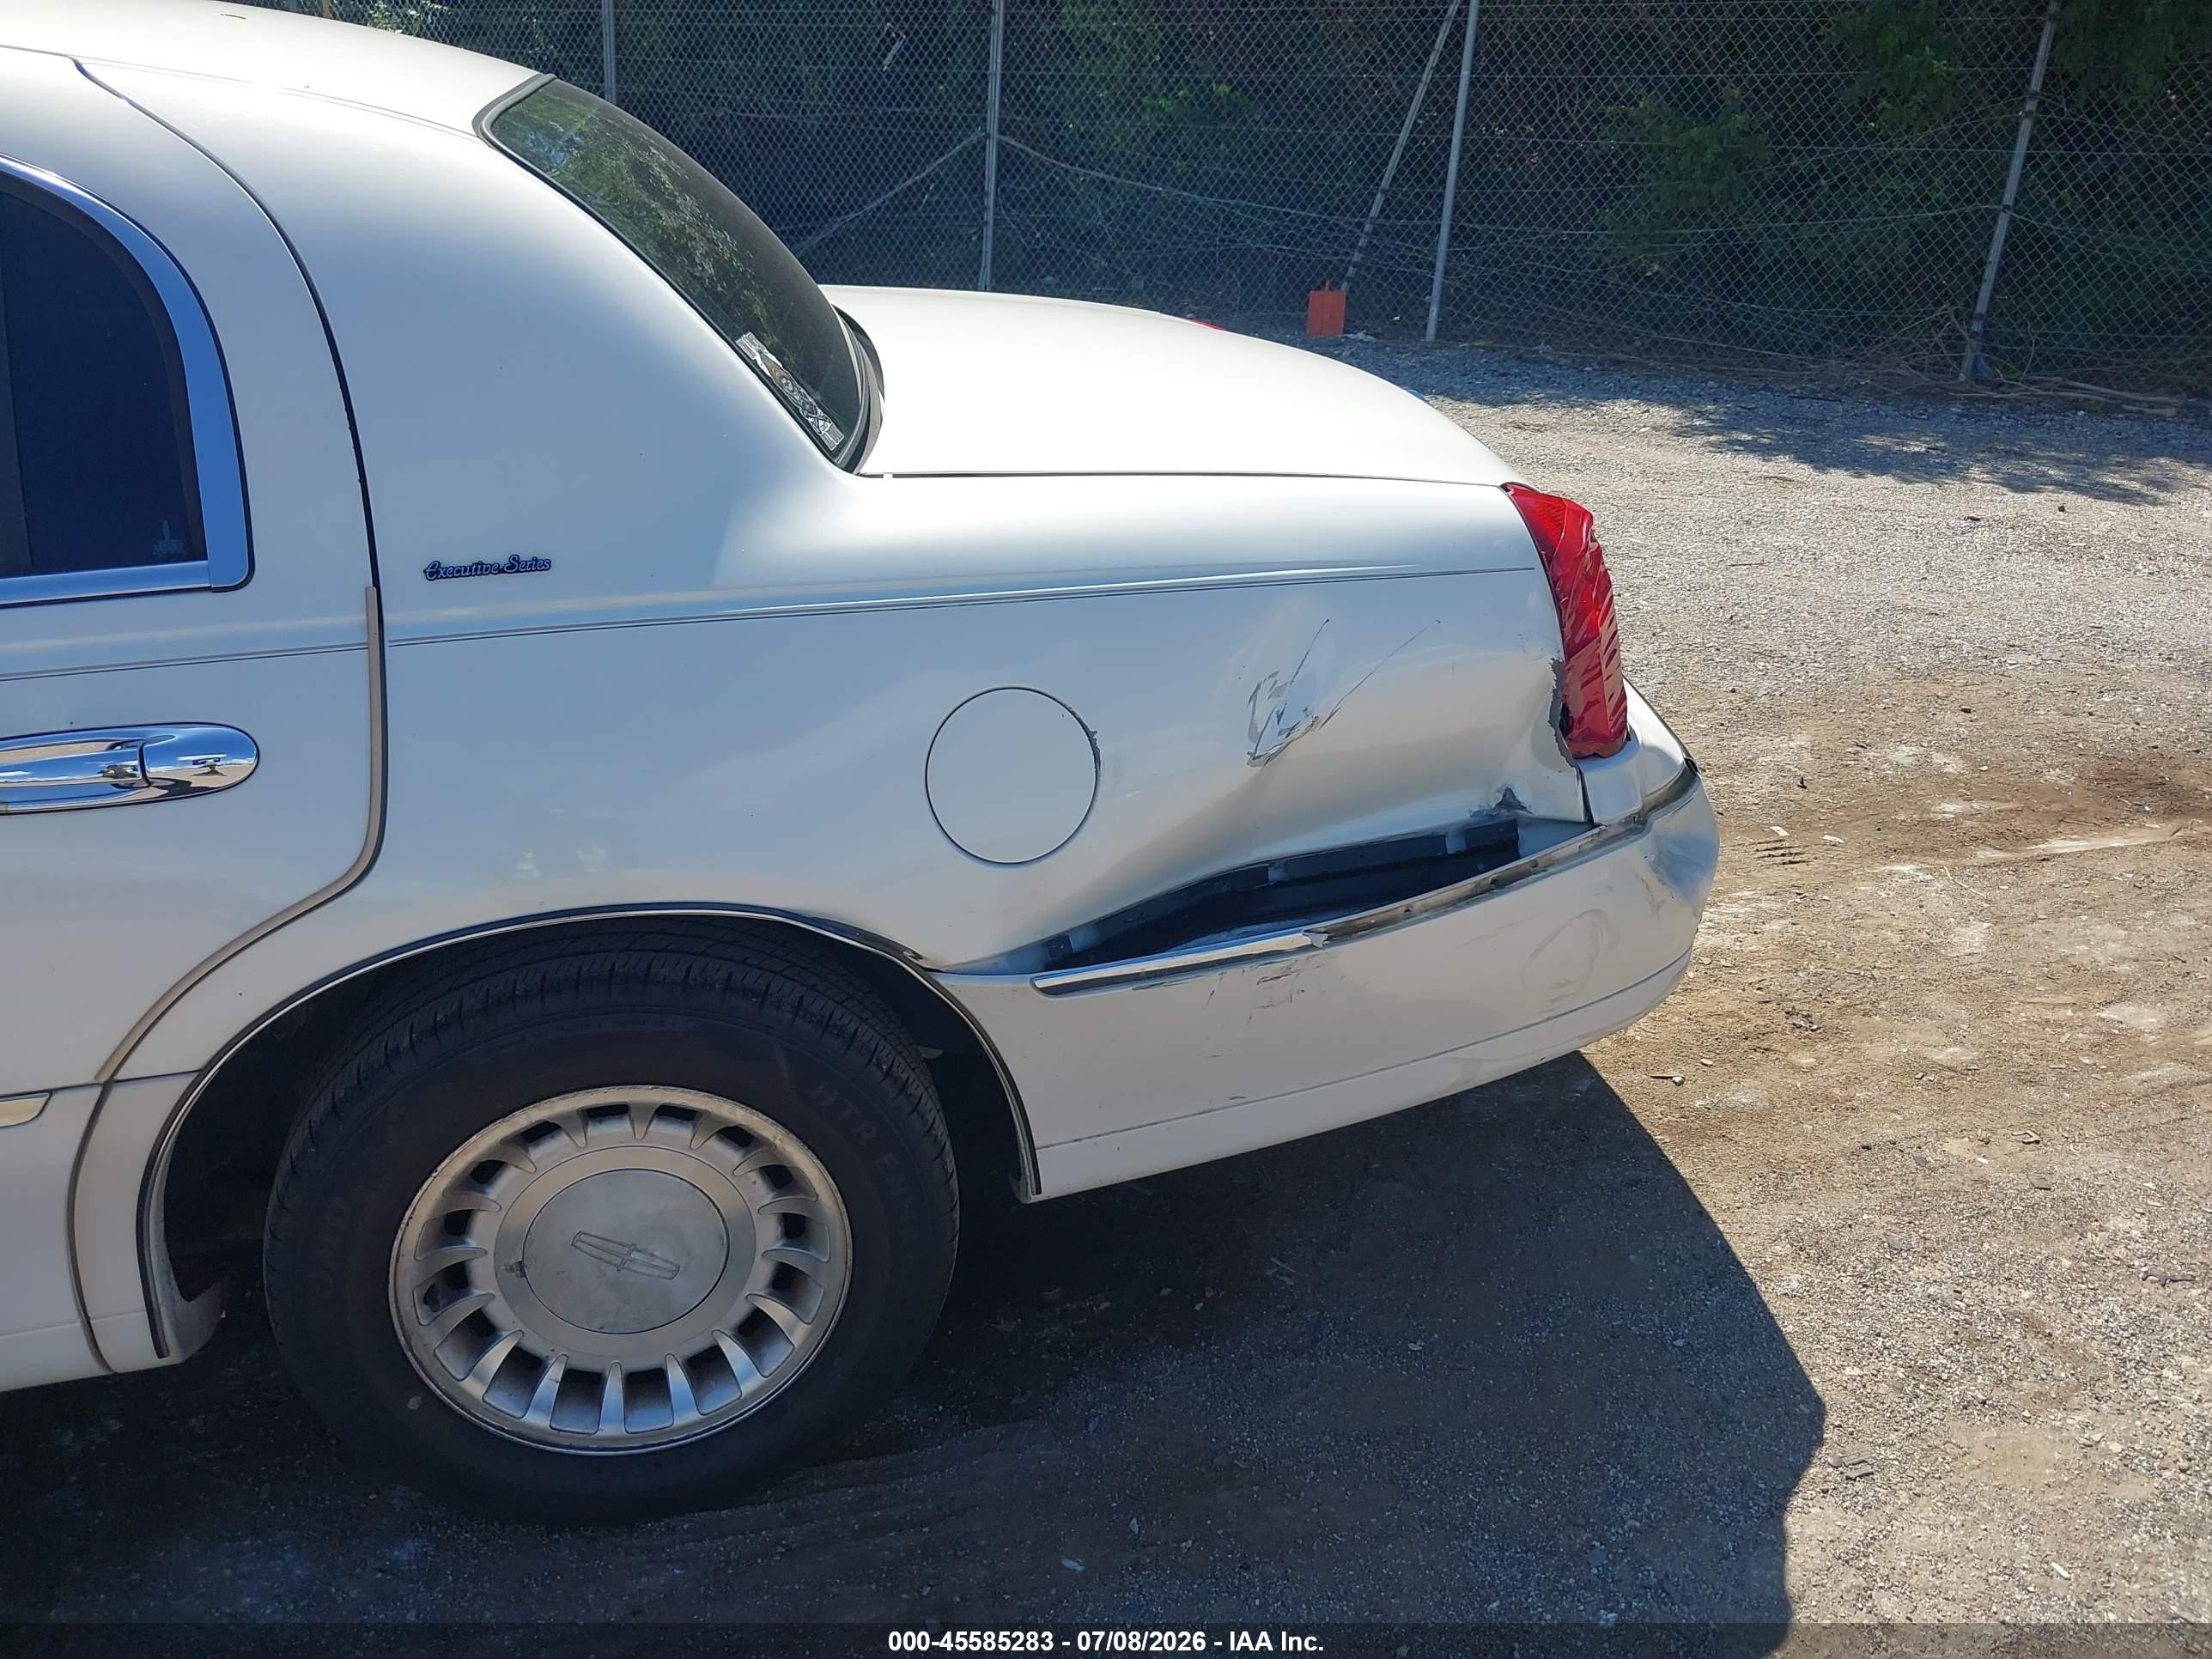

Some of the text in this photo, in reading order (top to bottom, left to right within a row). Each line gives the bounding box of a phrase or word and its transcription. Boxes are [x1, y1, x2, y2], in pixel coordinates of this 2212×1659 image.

[423, 554, 551, 580] Executive Series
[808, 1079, 878, 1147] HTR
